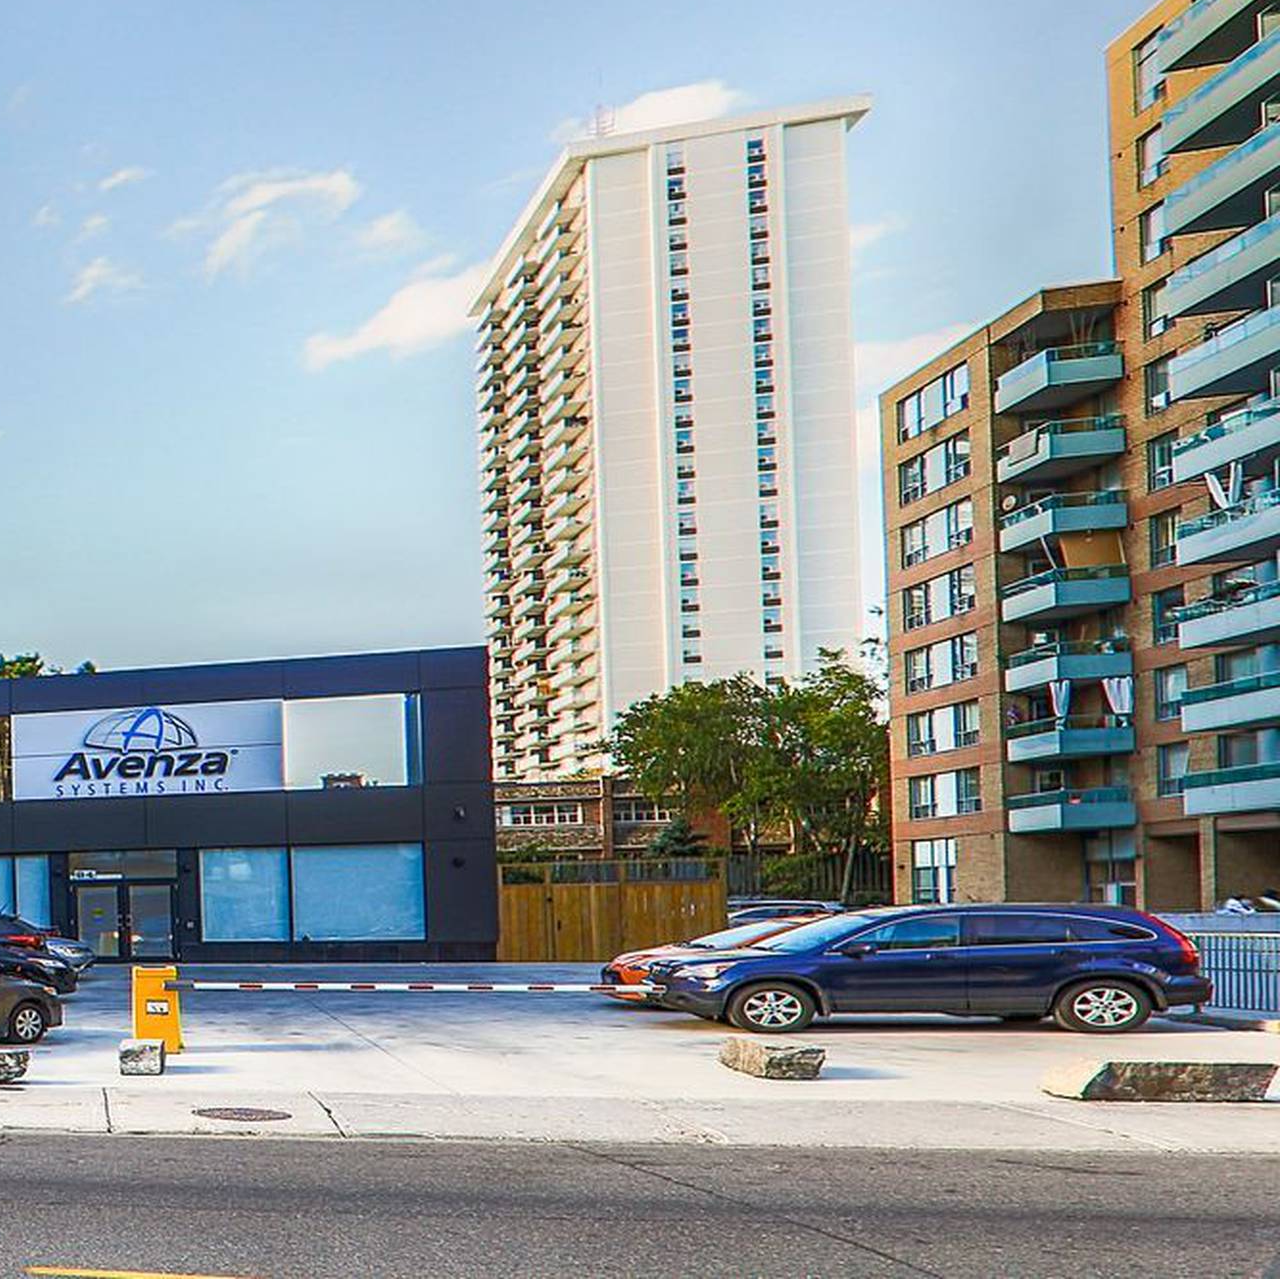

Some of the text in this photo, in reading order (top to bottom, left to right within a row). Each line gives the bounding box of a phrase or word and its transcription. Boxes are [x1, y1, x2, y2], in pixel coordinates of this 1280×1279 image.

[53, 751, 229, 782] Avenza
[56, 778, 229, 797] SYSTEMS INC.
